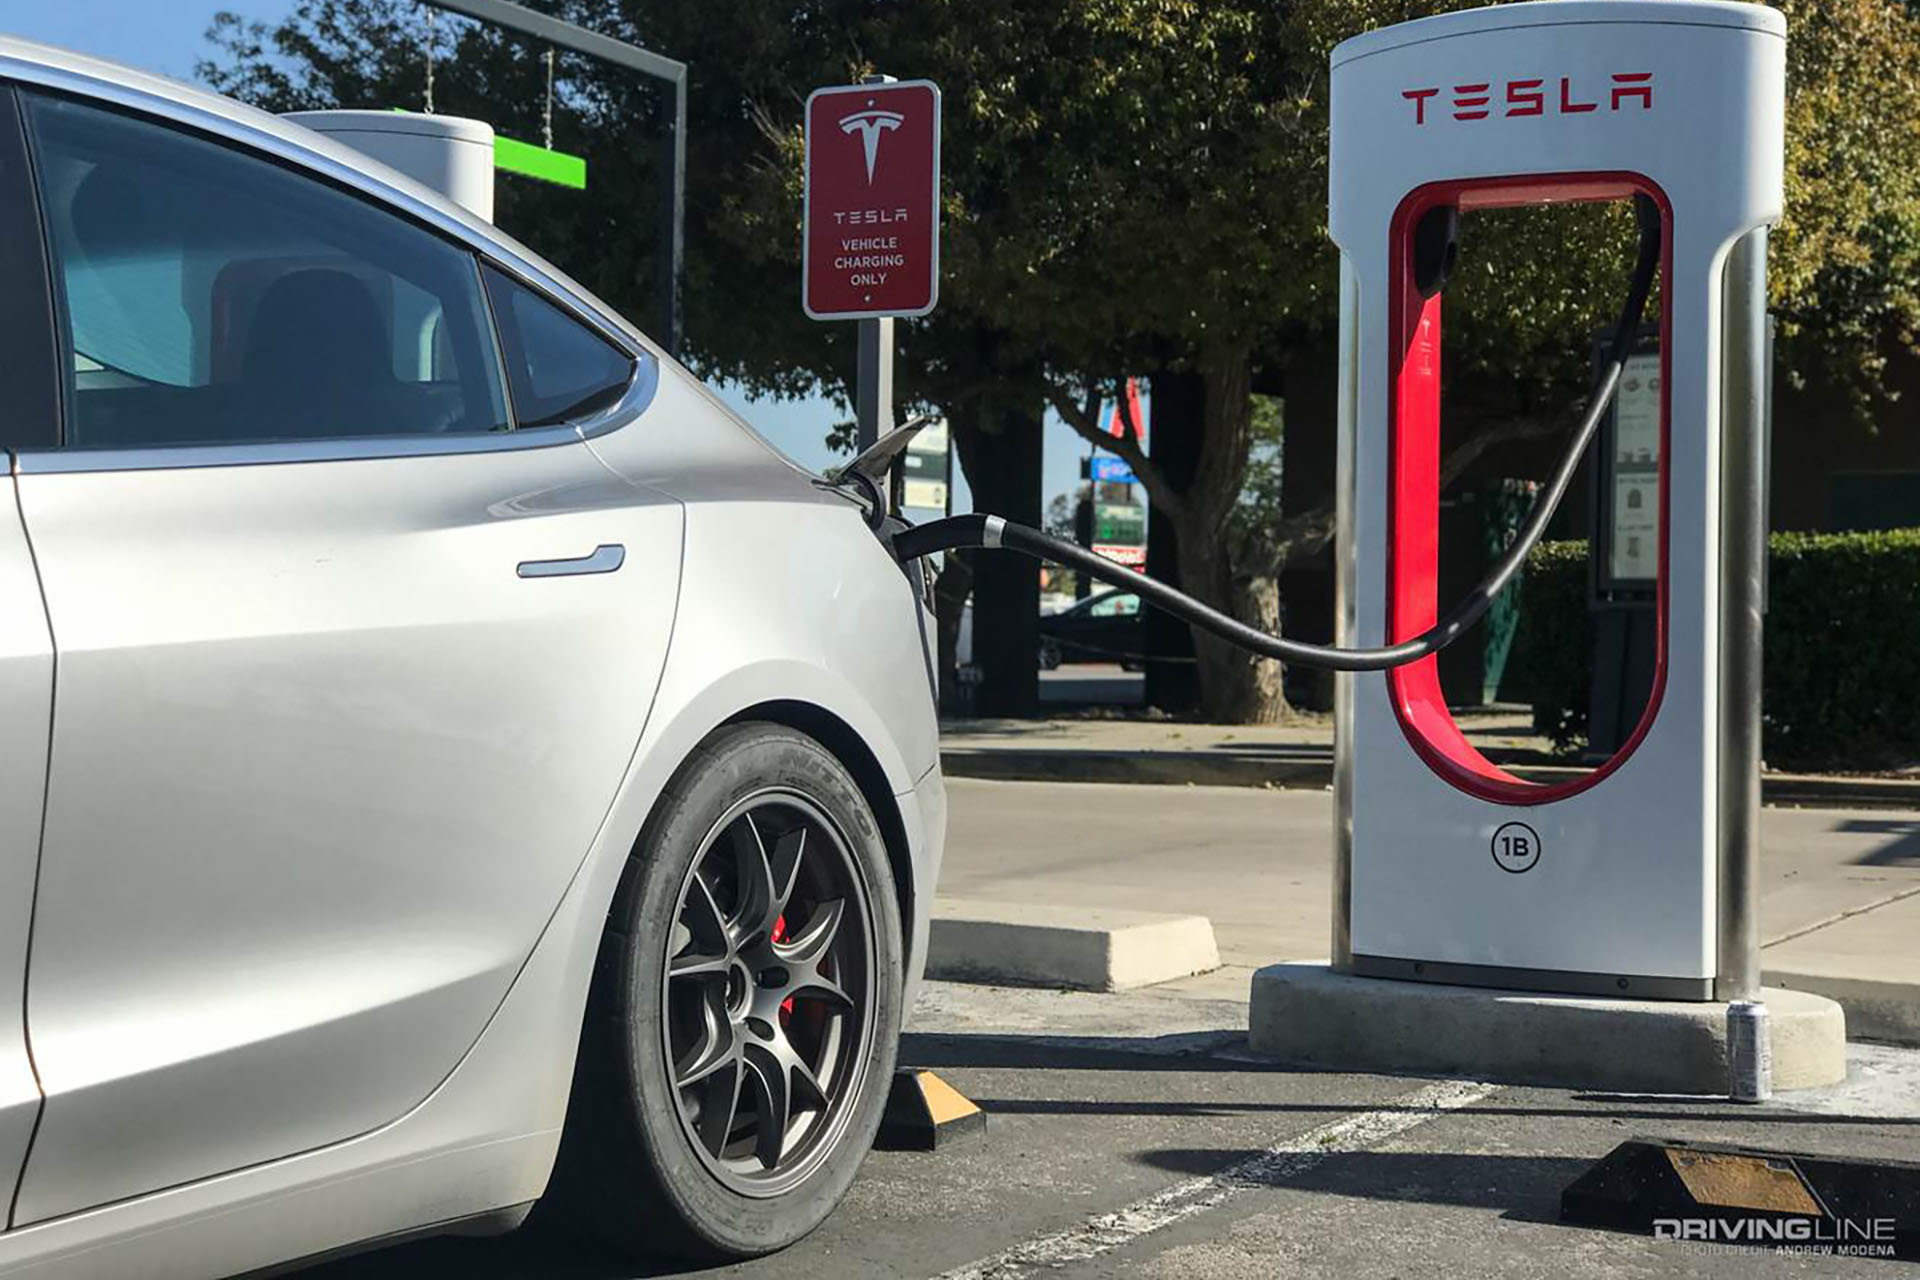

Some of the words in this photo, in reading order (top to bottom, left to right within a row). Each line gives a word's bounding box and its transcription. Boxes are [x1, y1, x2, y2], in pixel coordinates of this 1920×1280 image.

[1402, 73, 1652, 124] TESLA
[834, 209, 907, 224] TESLA
[842, 237, 897, 251] VEHICLE
[834, 255, 904, 269] CHARGING
[850, 273, 887, 286] ONLY
[1502, 837, 1529, 856] 1B
